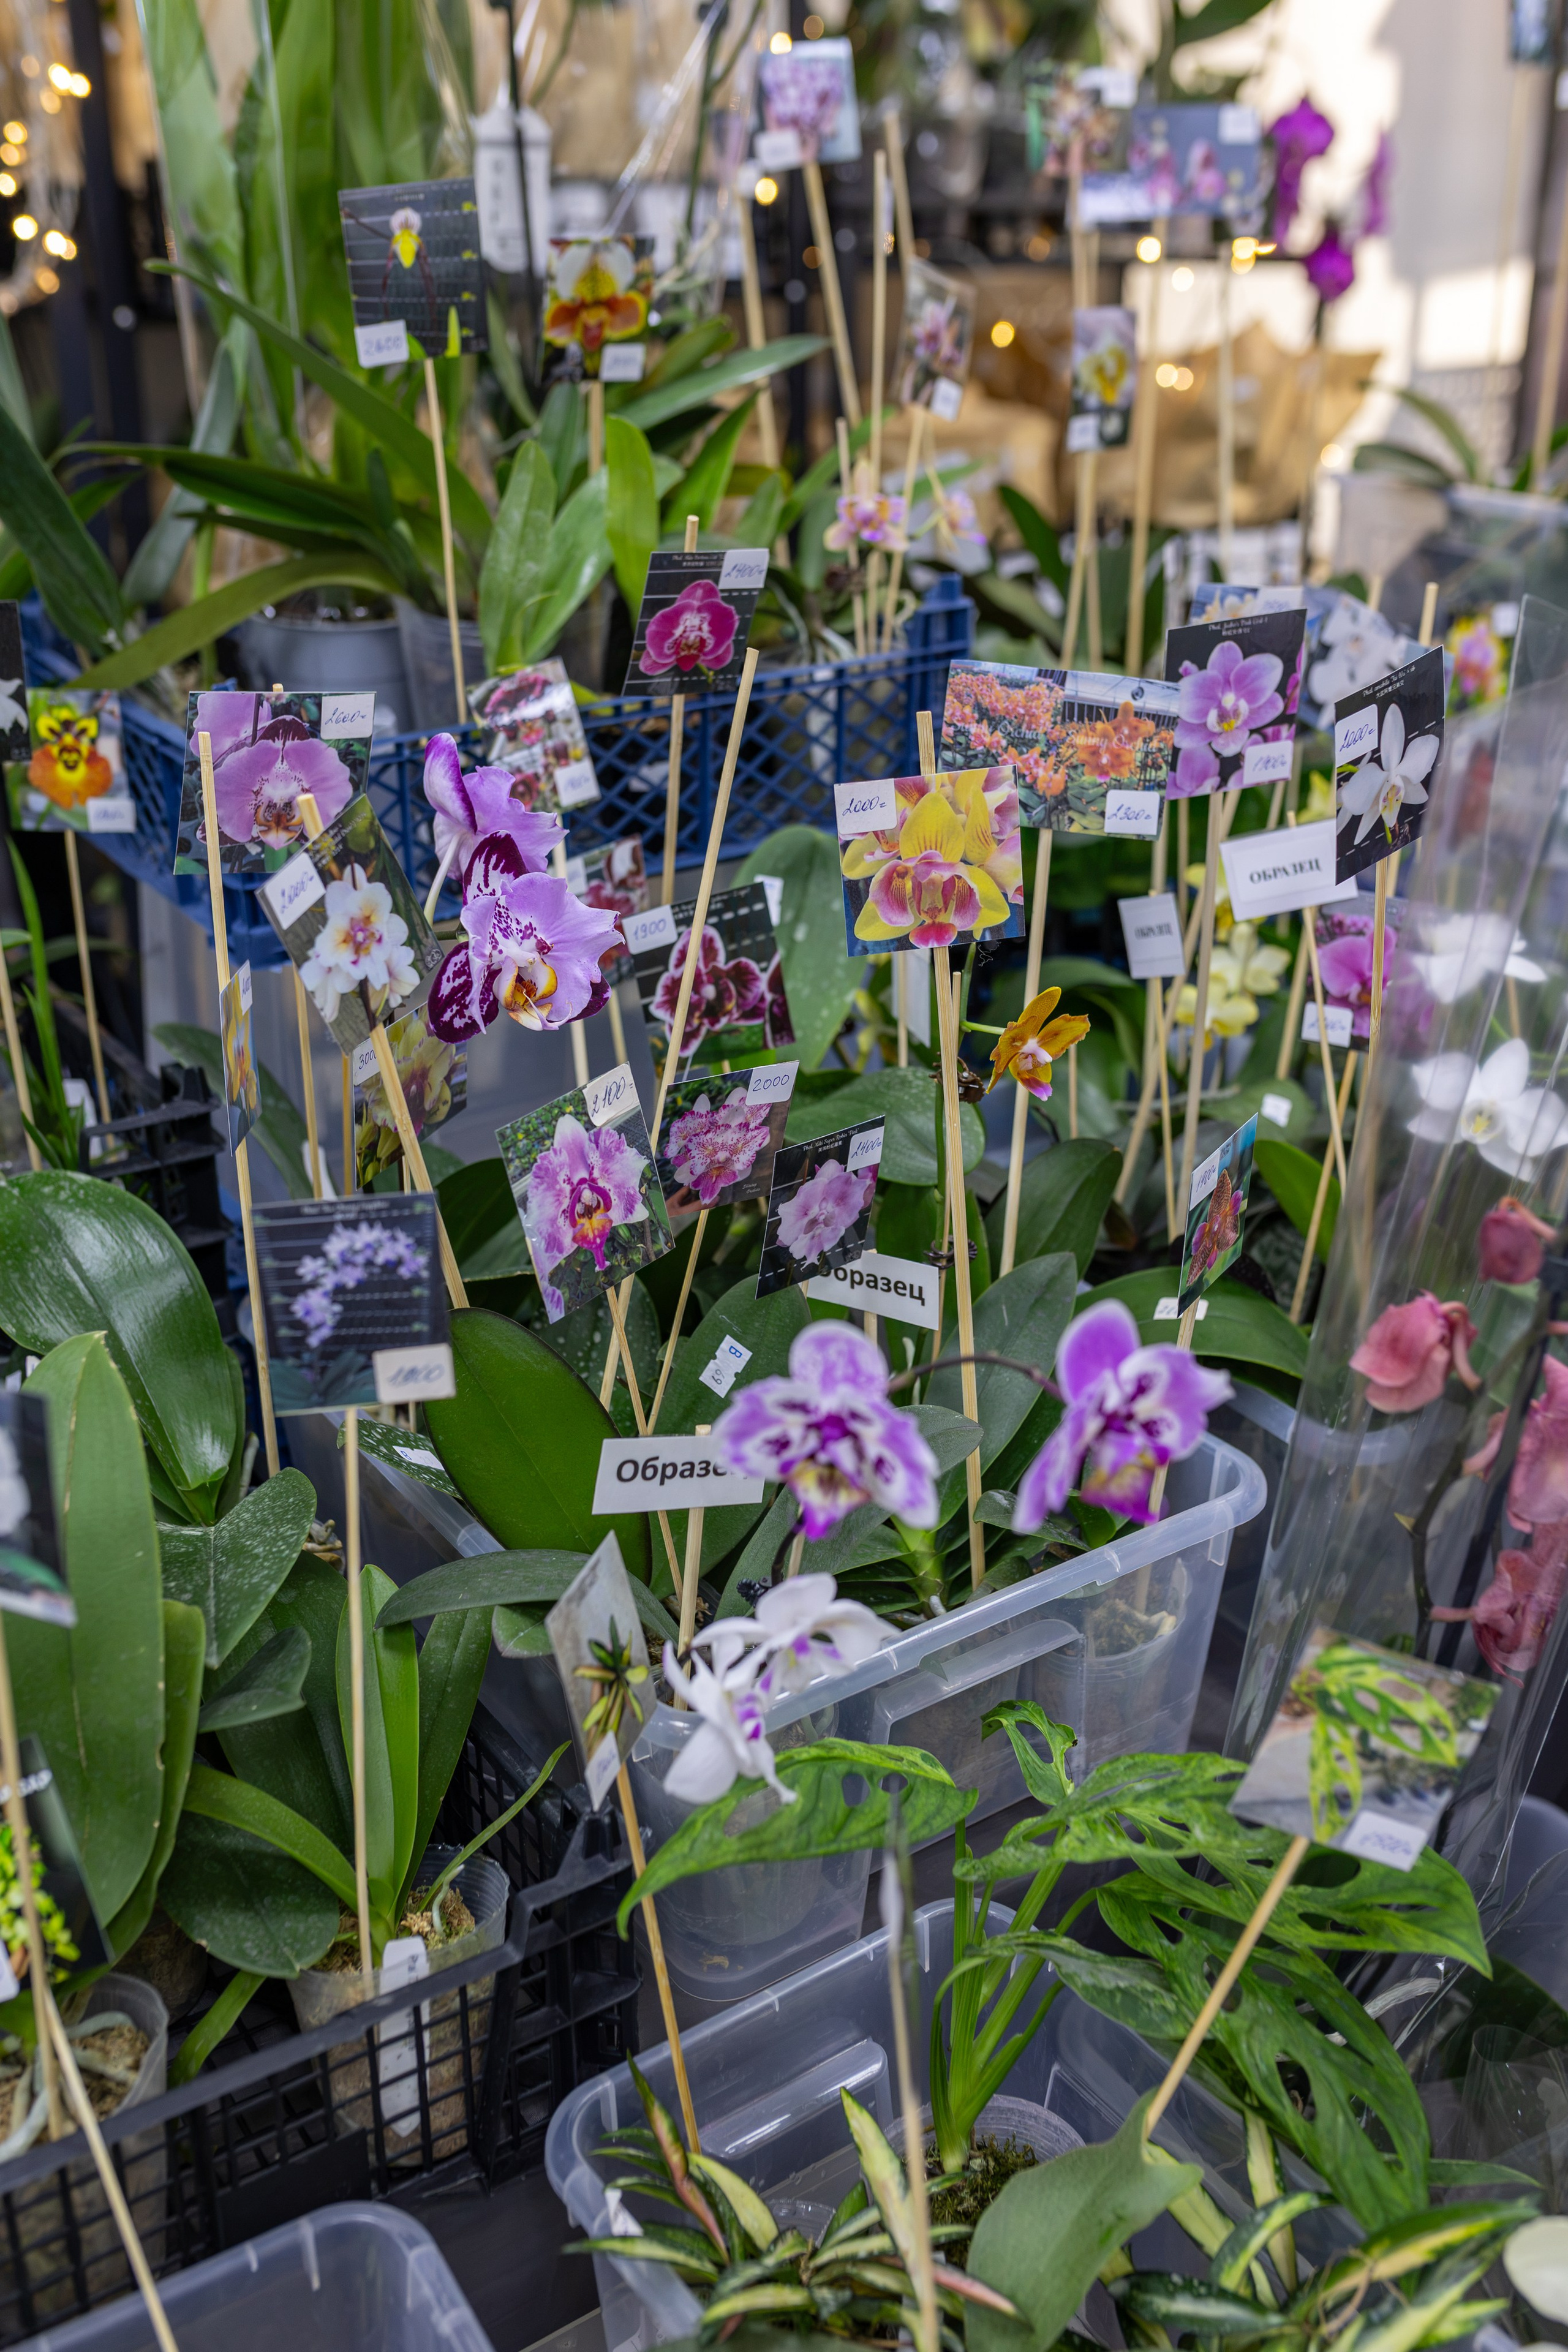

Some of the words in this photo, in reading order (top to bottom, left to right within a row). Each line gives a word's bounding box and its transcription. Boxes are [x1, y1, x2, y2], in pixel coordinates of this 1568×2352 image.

[1250, 858, 1322, 884] ОБРАЗЕЦ
[633, 918, 667, 941] 1900
[358, 1049, 377, 1069] 300
[752, 1074, 790, 1091] 2000
